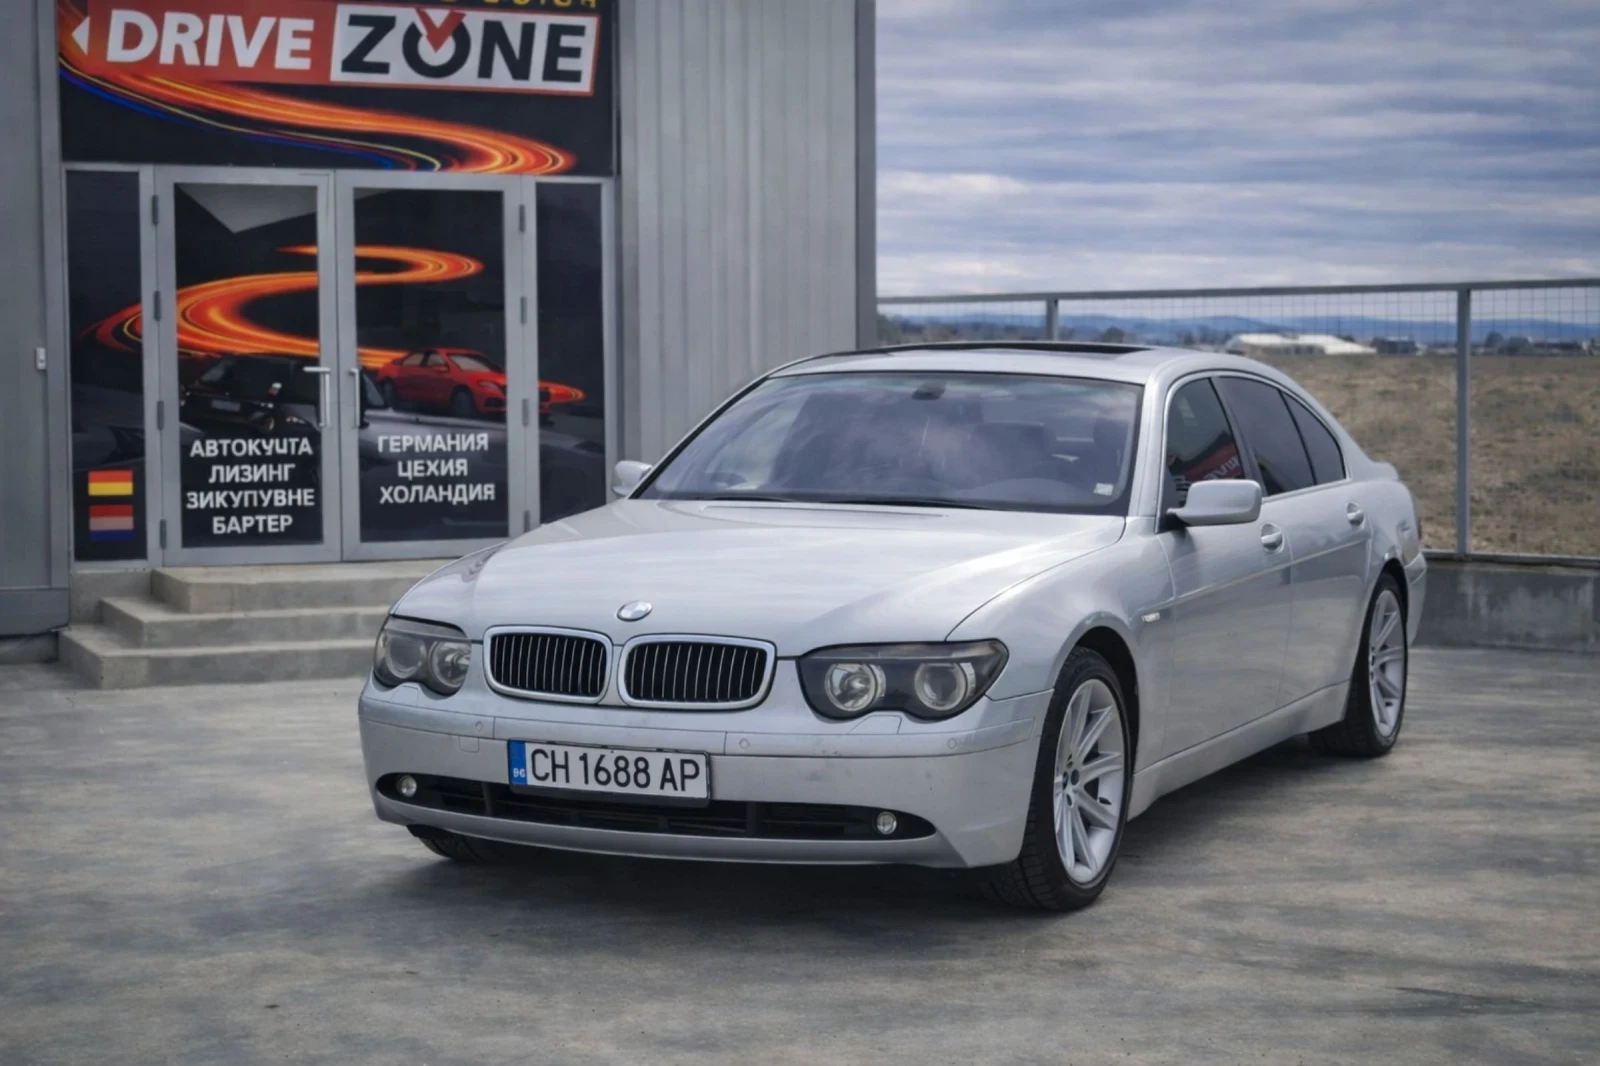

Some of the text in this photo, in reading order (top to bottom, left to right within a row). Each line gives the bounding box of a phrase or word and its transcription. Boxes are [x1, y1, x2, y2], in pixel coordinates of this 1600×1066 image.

[106, 9, 587, 83] DRIVE ZONE
[378, 433, 488, 453] ГЕРМАНИЯ
[208, 463, 296, 483] ЛИЗИНГ
[397, 458, 468, 480] ЦЕХИЯ
[380, 483, 495, 505] ХОЛАНДИЯ
[212, 515, 293, 534] БАРТЕР
[531, 749, 700, 791] CH 1688 AP
